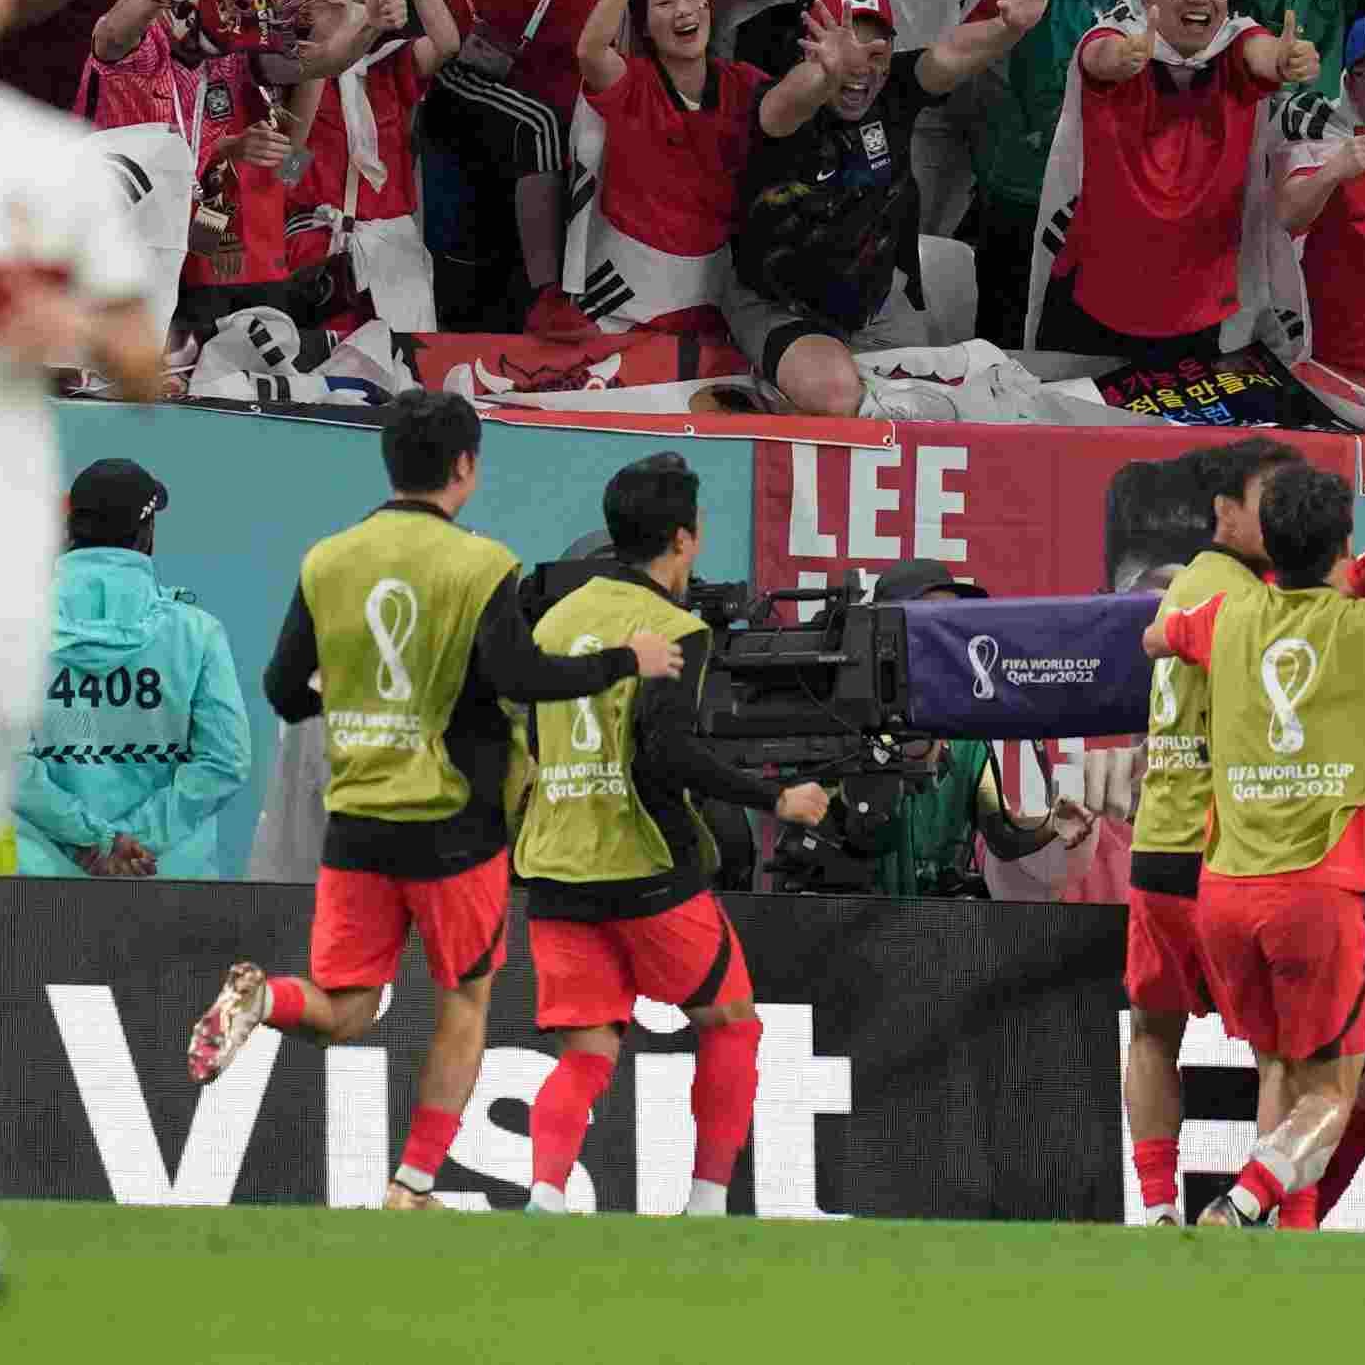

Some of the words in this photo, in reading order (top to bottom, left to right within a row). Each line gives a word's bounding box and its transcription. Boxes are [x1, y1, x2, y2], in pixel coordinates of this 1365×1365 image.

[788, 443, 970, 561] LEE
[1002, 659, 1032, 670] FIFA
[1033, 659, 1075, 670] WORLD
[1075, 659, 1101, 670] CUP
[47, 665, 163, 710] 4408
[1227, 763, 1260, 781] FIFA
[1261, 762, 1321, 779] WORLD
[1323, 761, 1355, 777] CUP
[46, 983, 851, 1220] Visit
